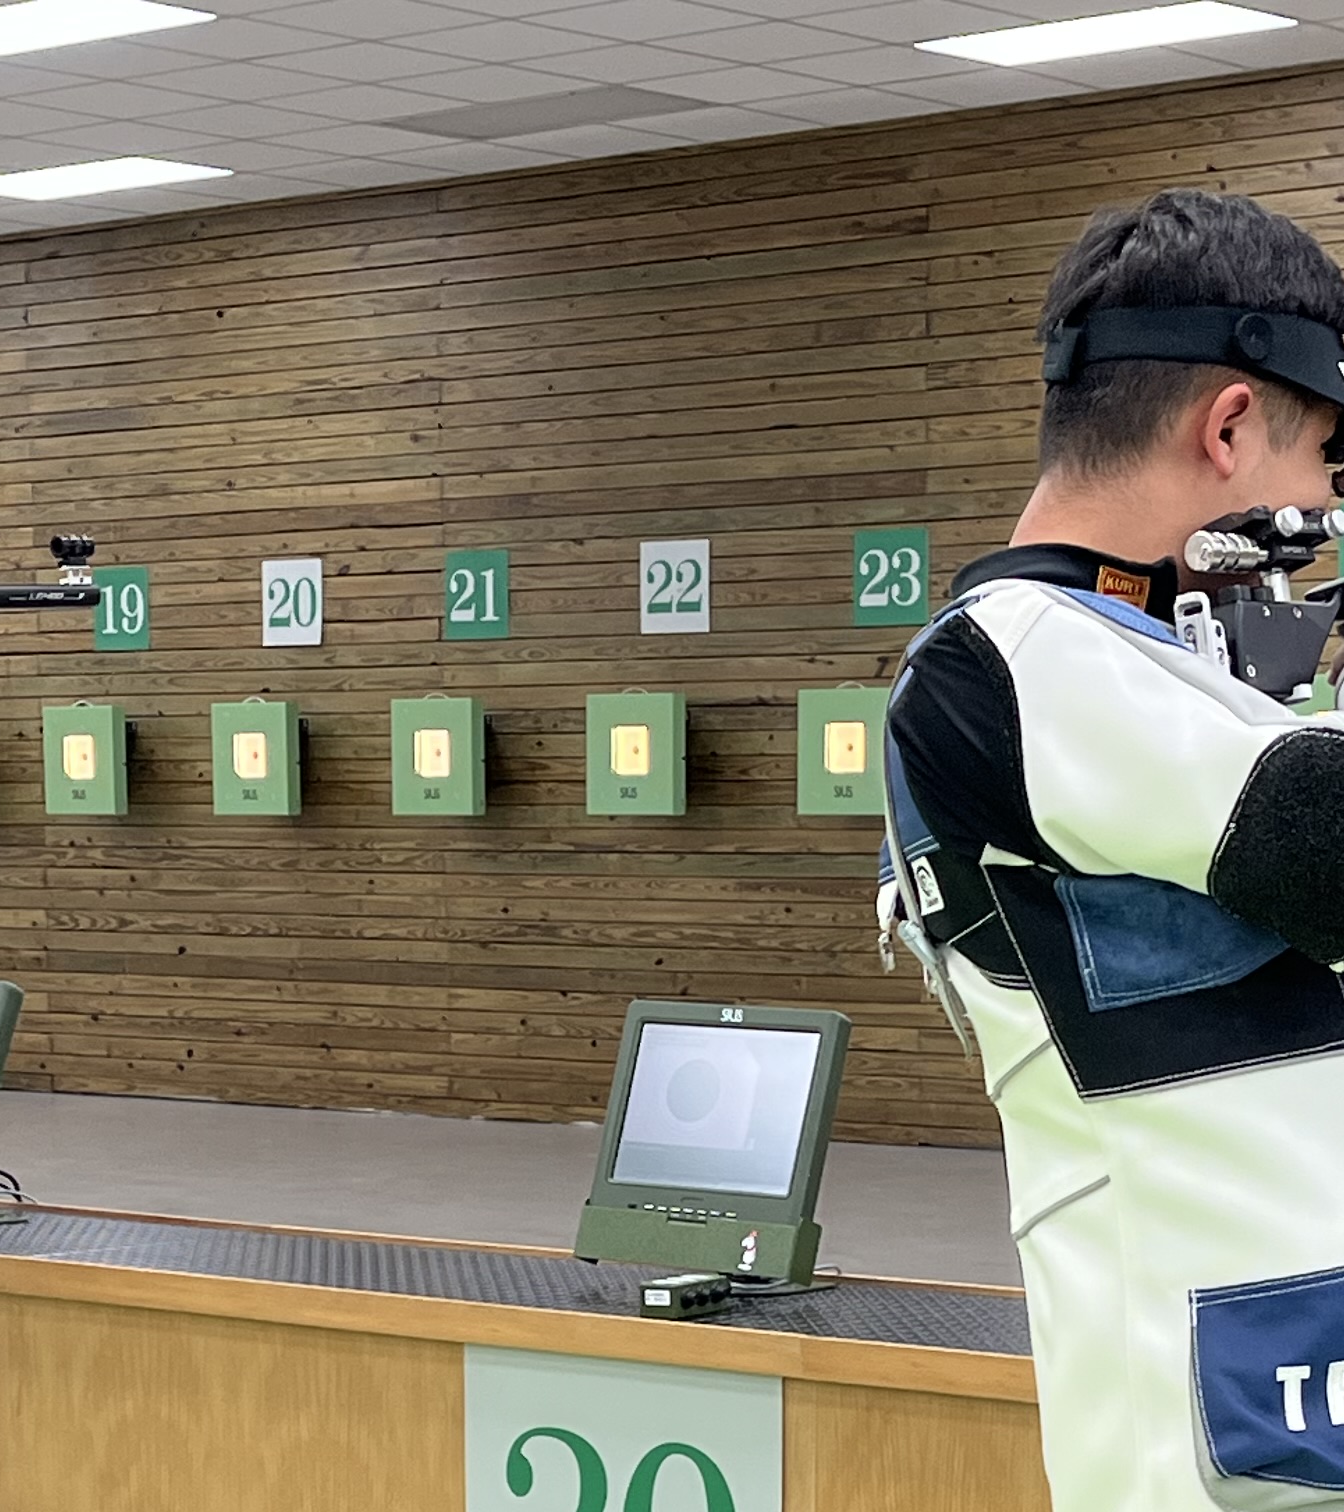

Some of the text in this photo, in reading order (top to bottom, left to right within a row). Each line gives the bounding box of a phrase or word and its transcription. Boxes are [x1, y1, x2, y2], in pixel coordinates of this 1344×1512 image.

[267, 576, 317, 628] 20
[449, 568, 500, 622] 21
[646, 559, 704, 613] 22
[858, 548, 922, 607] 23
[1104, 573, 1142, 594] KURT
[100, 583, 146, 635] 19
